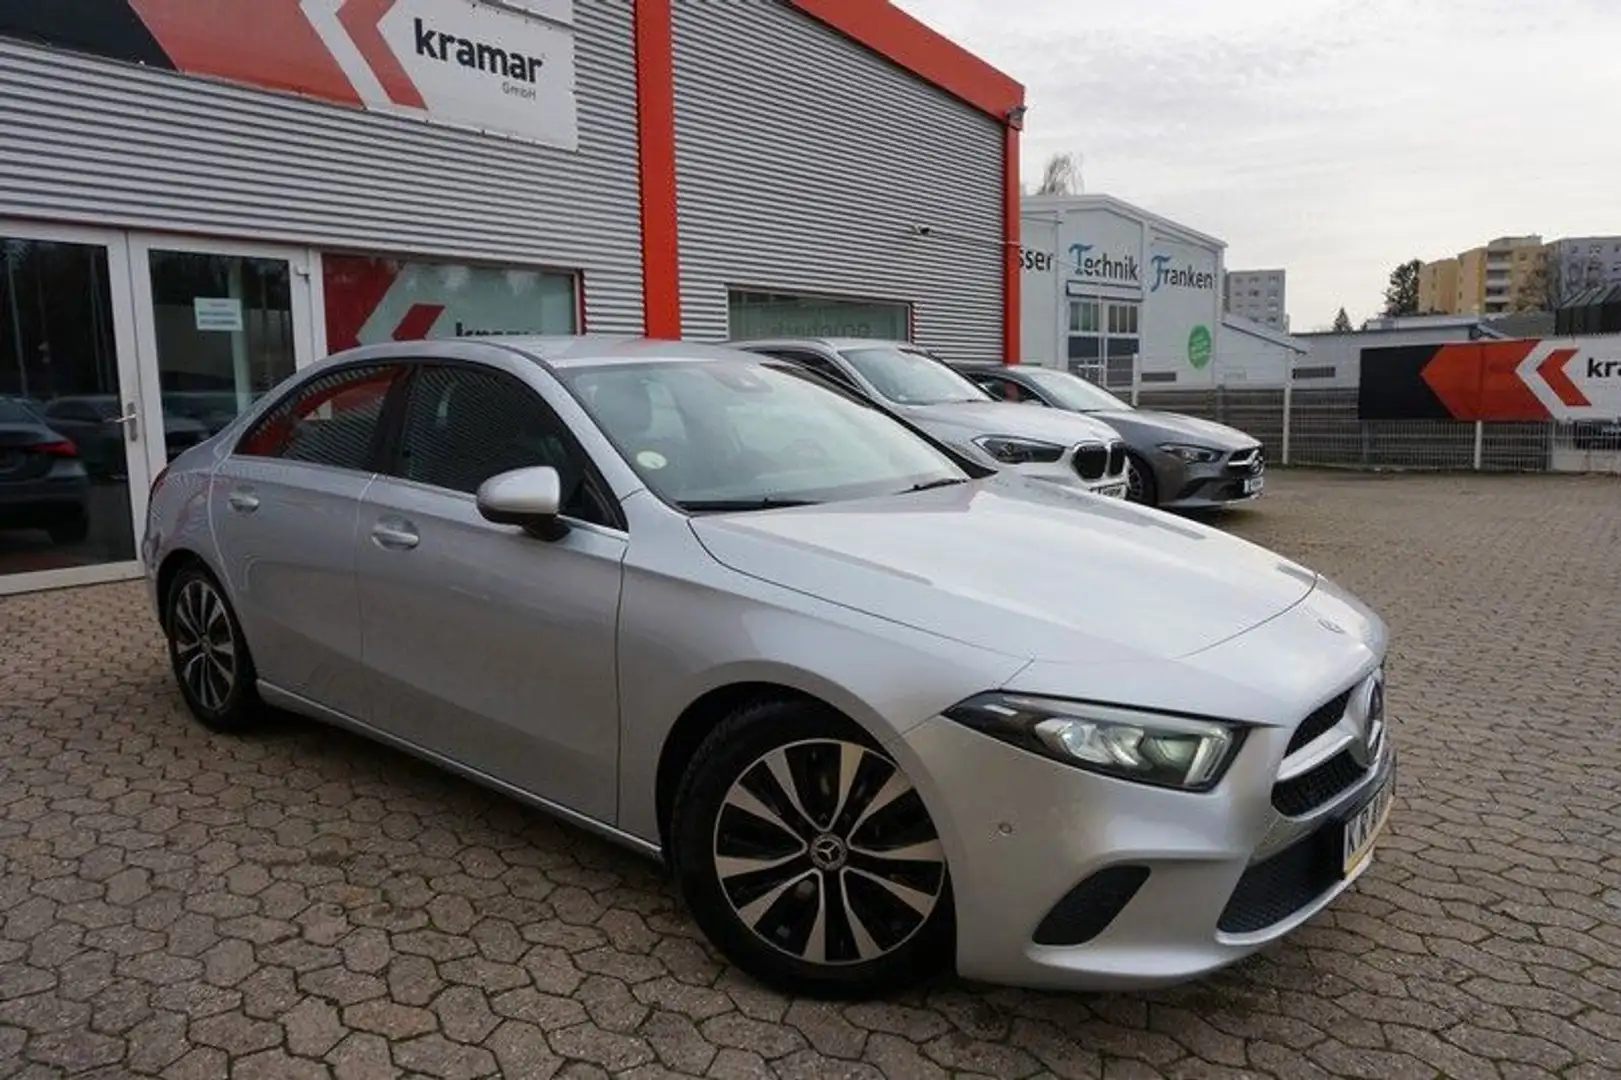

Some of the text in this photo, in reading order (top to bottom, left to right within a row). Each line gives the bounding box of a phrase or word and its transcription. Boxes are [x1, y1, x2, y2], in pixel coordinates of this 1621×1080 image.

[414, 17, 543, 83] kramar
[502, 82, 536, 100] GmbH
[1069, 243, 1139, 281] Technik
[1151, 255, 1213, 292] Franken
